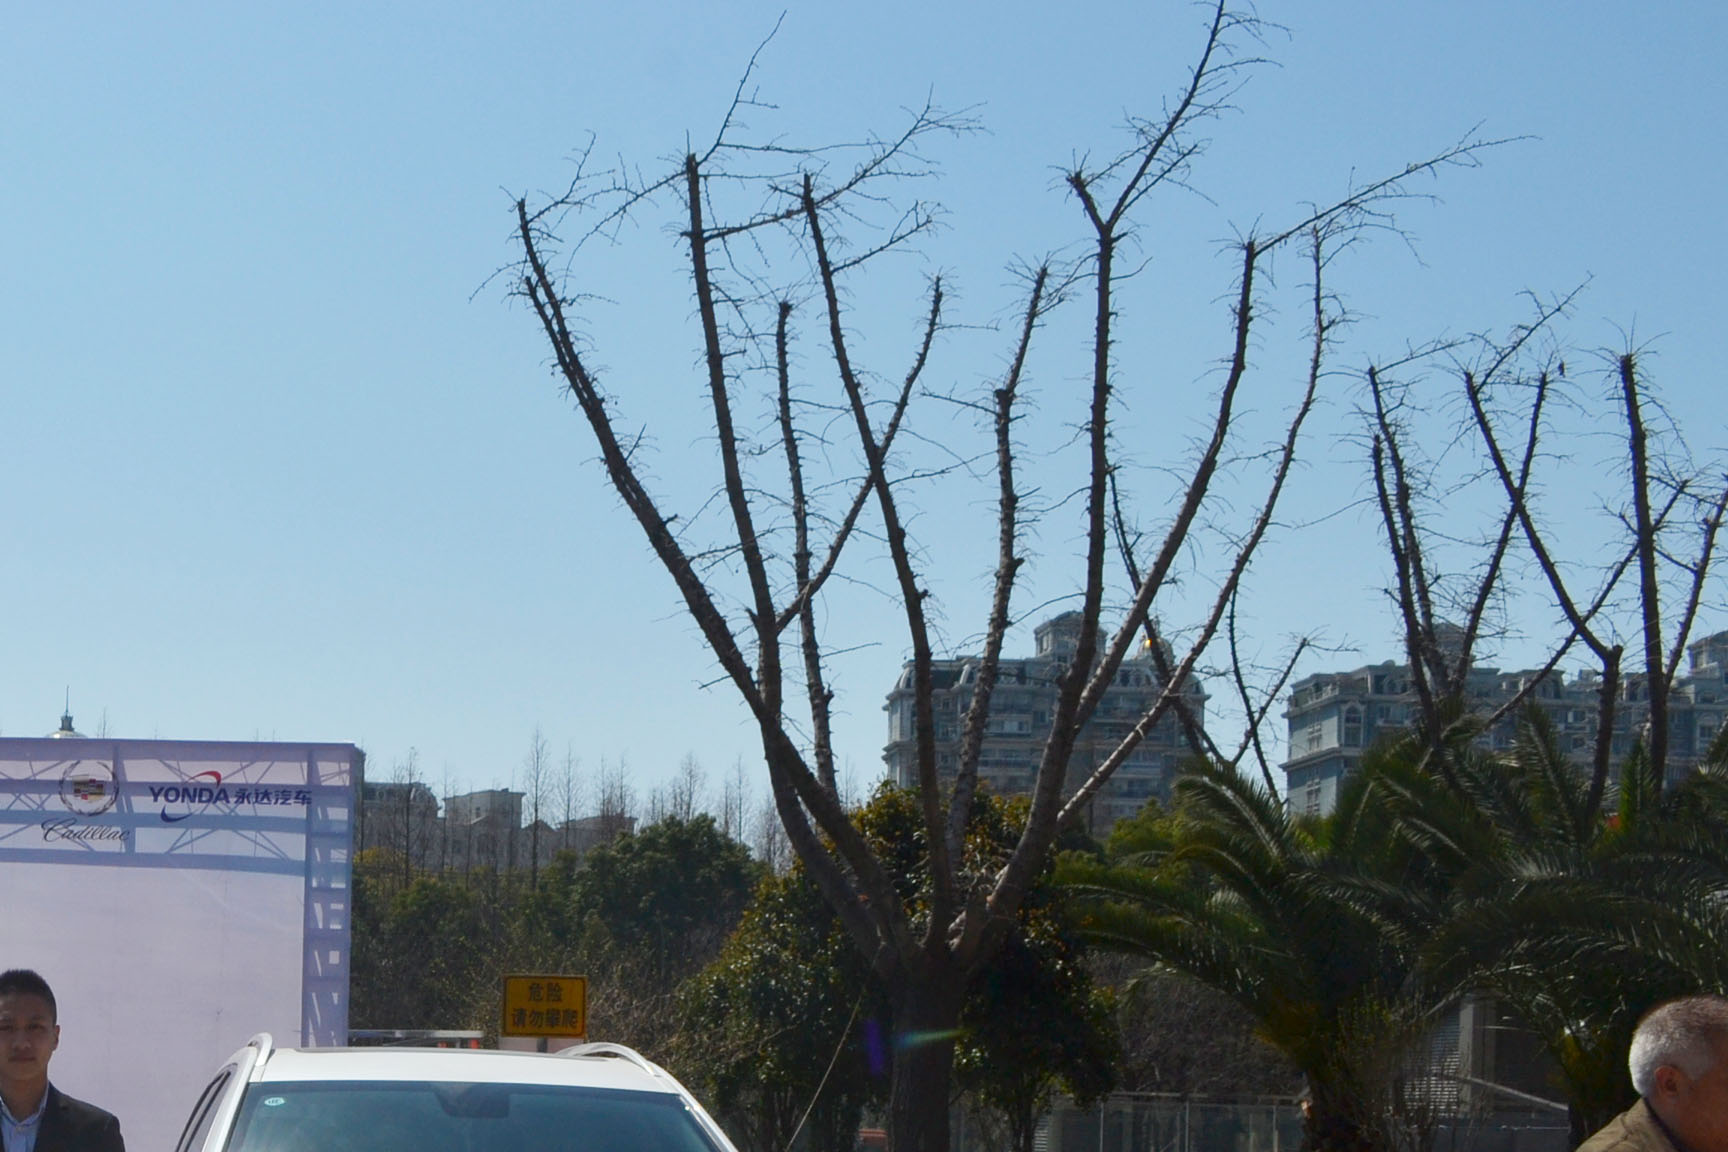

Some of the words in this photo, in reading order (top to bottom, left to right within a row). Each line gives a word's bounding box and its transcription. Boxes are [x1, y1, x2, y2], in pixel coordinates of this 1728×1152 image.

[149, 785, 231, 804] YONDA
[234, 787, 313, 806] 永达汽车
[40, 816, 130, 843] Cadillac
